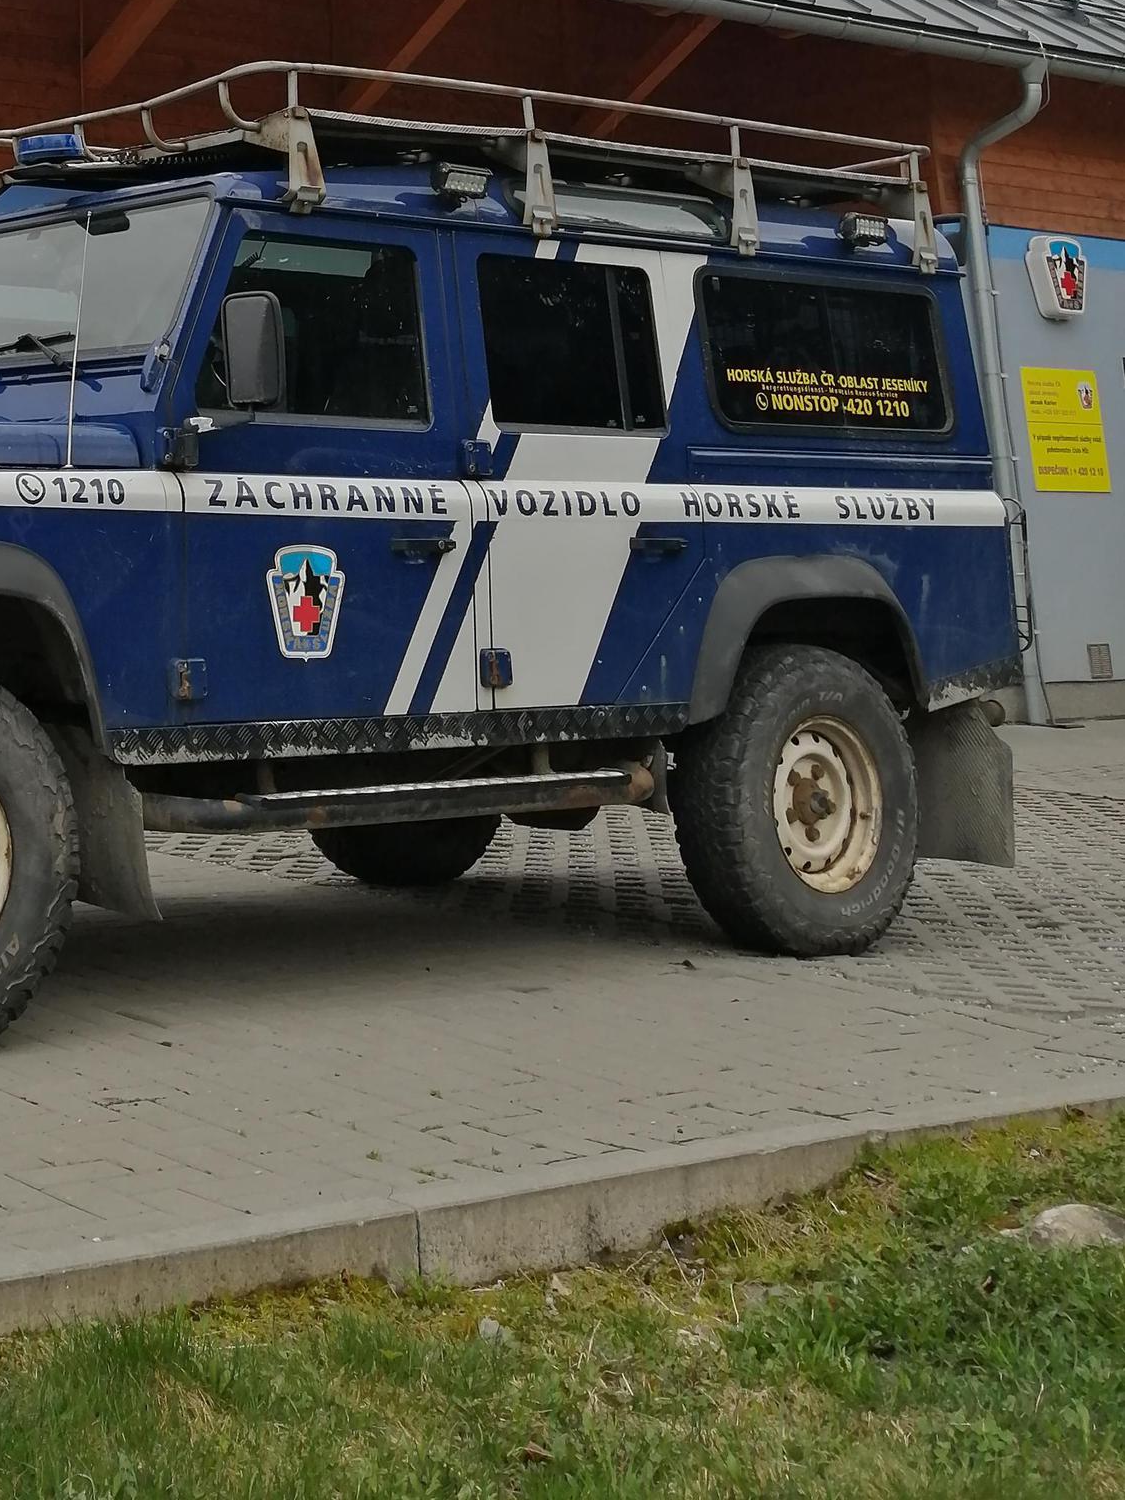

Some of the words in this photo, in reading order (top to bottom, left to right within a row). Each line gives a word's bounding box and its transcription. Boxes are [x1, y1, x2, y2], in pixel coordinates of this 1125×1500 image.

[726, 367, 774, 384] HORSKÁ
[776, 369, 818, 386] SLUŽBA
[820, 370, 835, 387] ČR
[881, 377, 928, 393] JESENÍKY
[771, 393, 839, 413] NONSTOP
[876, 399, 910, 418] 1210
[51, 476, 125, 505] 1210
[204, 476, 448, 514] ZÁCHRANNÉ
[487, 488, 642, 518] VOZIDLO
[679, 490, 801, 520] HORSKÉ
[835, 492, 936, 521] SLUŽBY
